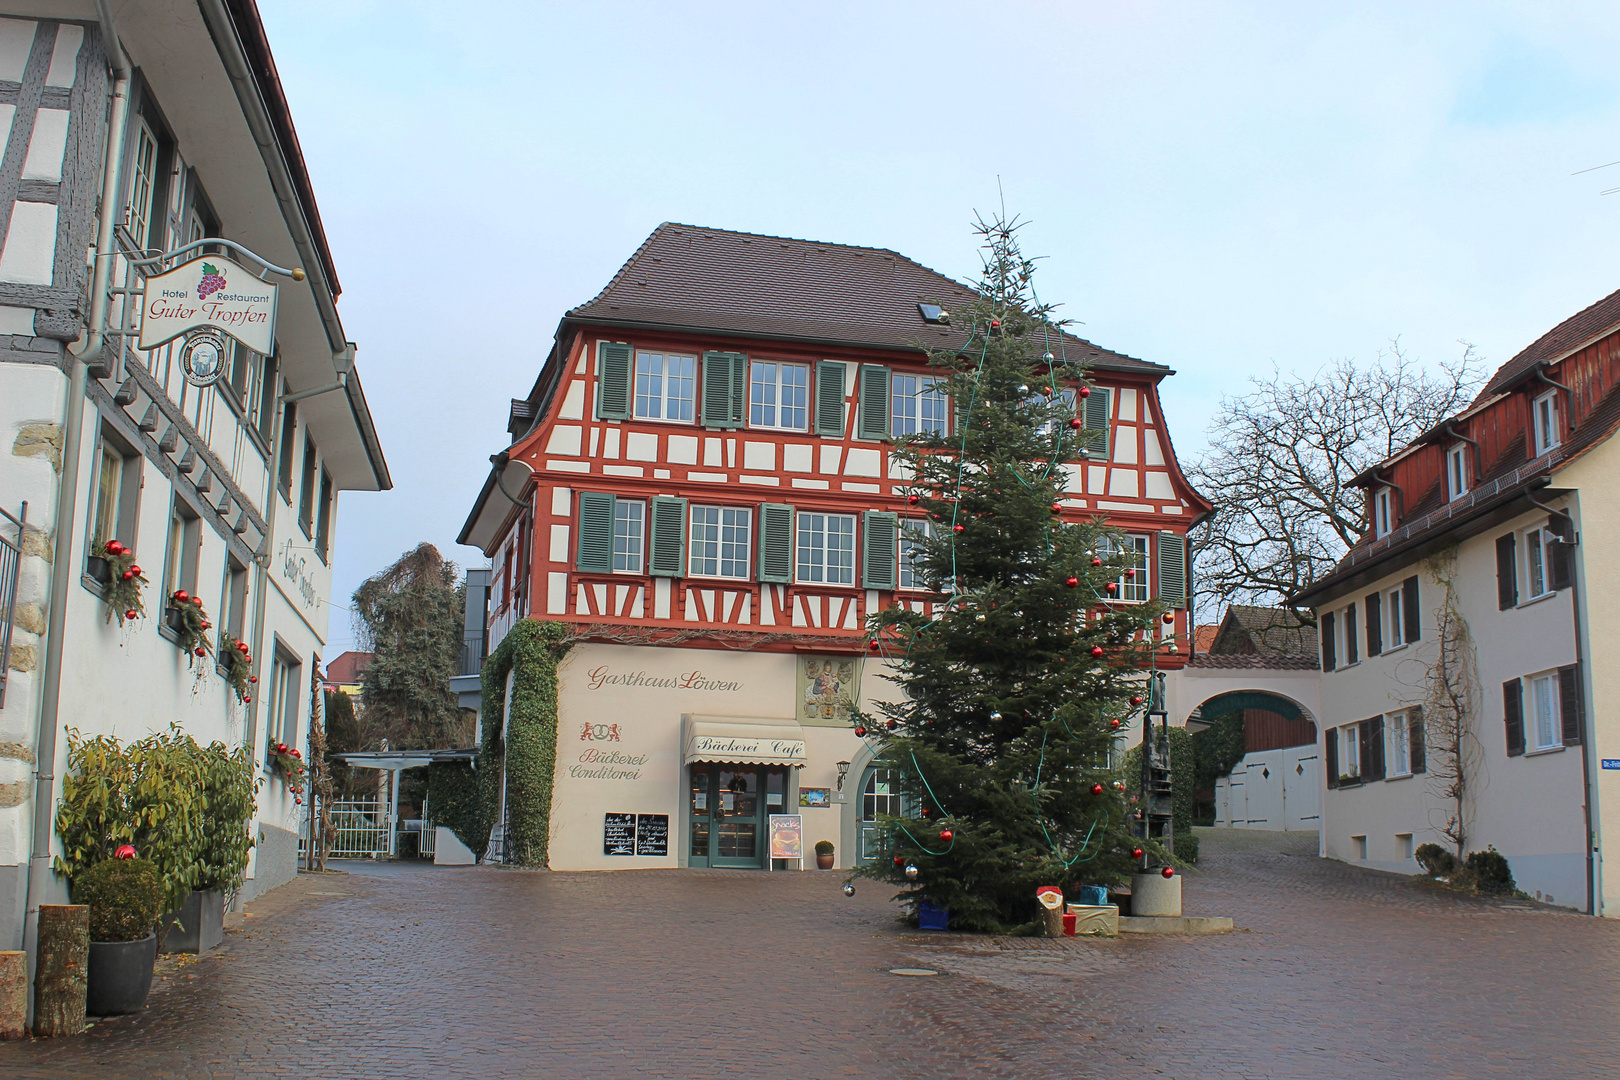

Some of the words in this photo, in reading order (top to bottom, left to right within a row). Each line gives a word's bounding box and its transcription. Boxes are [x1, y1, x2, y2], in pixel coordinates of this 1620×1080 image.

[162, 289, 188, 299] Hotel
[217, 292, 269, 303] Restaurant
[149, 299, 197, 319] Guter
[202, 302, 267, 325] Tropfen
[587, 665, 679, 690] Gasthaus
[678, 670, 744, 691] Löwen
[579, 748, 649, 766] Bäckerei
[697, 738, 759, 752] Bäckerei
[771, 740, 804, 758] Café
[569, 764, 643, 780] Conditorei
[771, 819, 801, 831] Snacks
